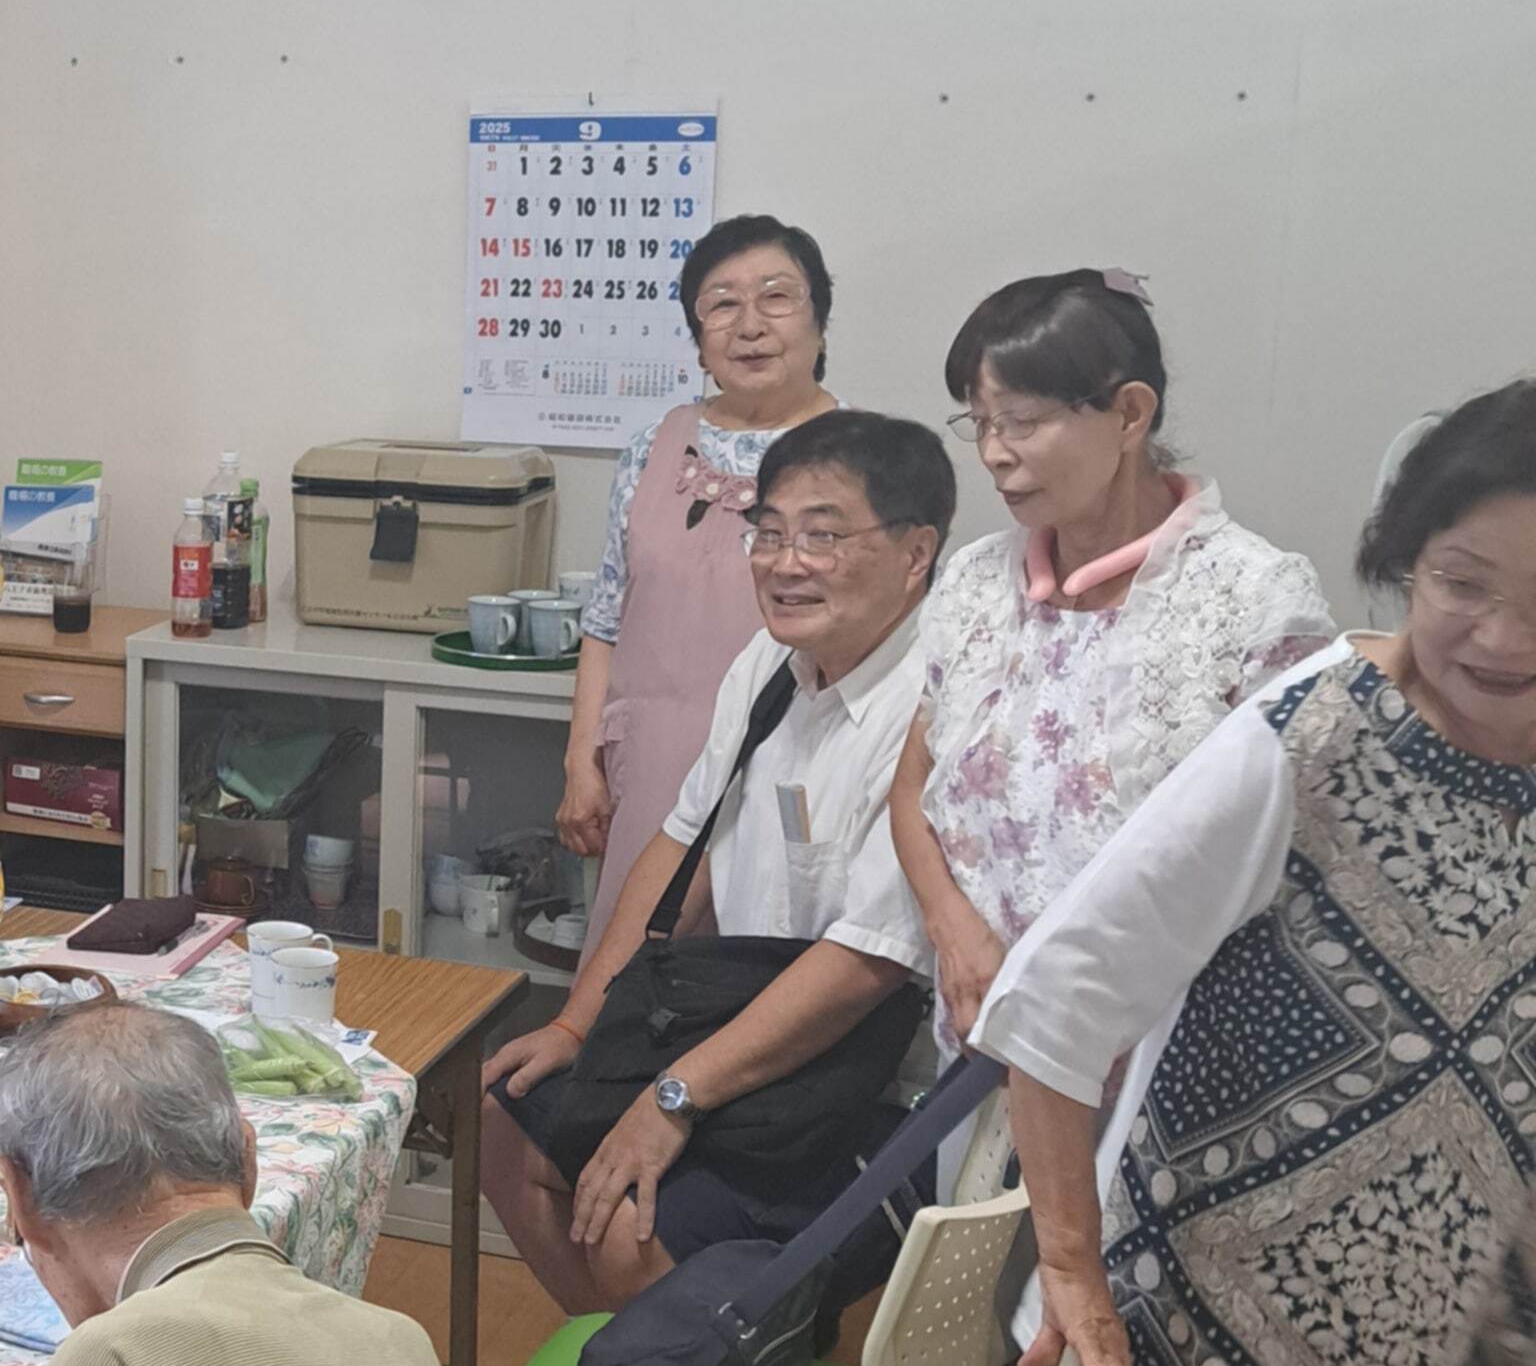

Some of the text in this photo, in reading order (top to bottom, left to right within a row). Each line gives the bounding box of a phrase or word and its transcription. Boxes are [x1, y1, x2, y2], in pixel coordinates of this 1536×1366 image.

[479, 122, 511, 134] 2025
[579, 121, 601, 141] 9
[520, 156, 528, 176] 1
[549, 156, 563, 176] 2
[581, 156, 594, 176] 3
[613, 156, 626, 176] 4
[646, 156, 659, 177] 5
[678, 156, 692, 177] 6
[484, 197, 694, 218] 7 8 9 10 11 12 13
[480, 238, 693, 260] 14 15 16 17 18 19 20
[480, 278, 680, 301] 21 22 23 24 25 26 2
[478, 318, 500, 337] 28
[509, 318, 531, 338] 29
[539, 319, 562, 339] 30
[579, 323, 585, 334] 1
[610, 324, 617, 336] 2
[641, 325, 649, 336] 3
